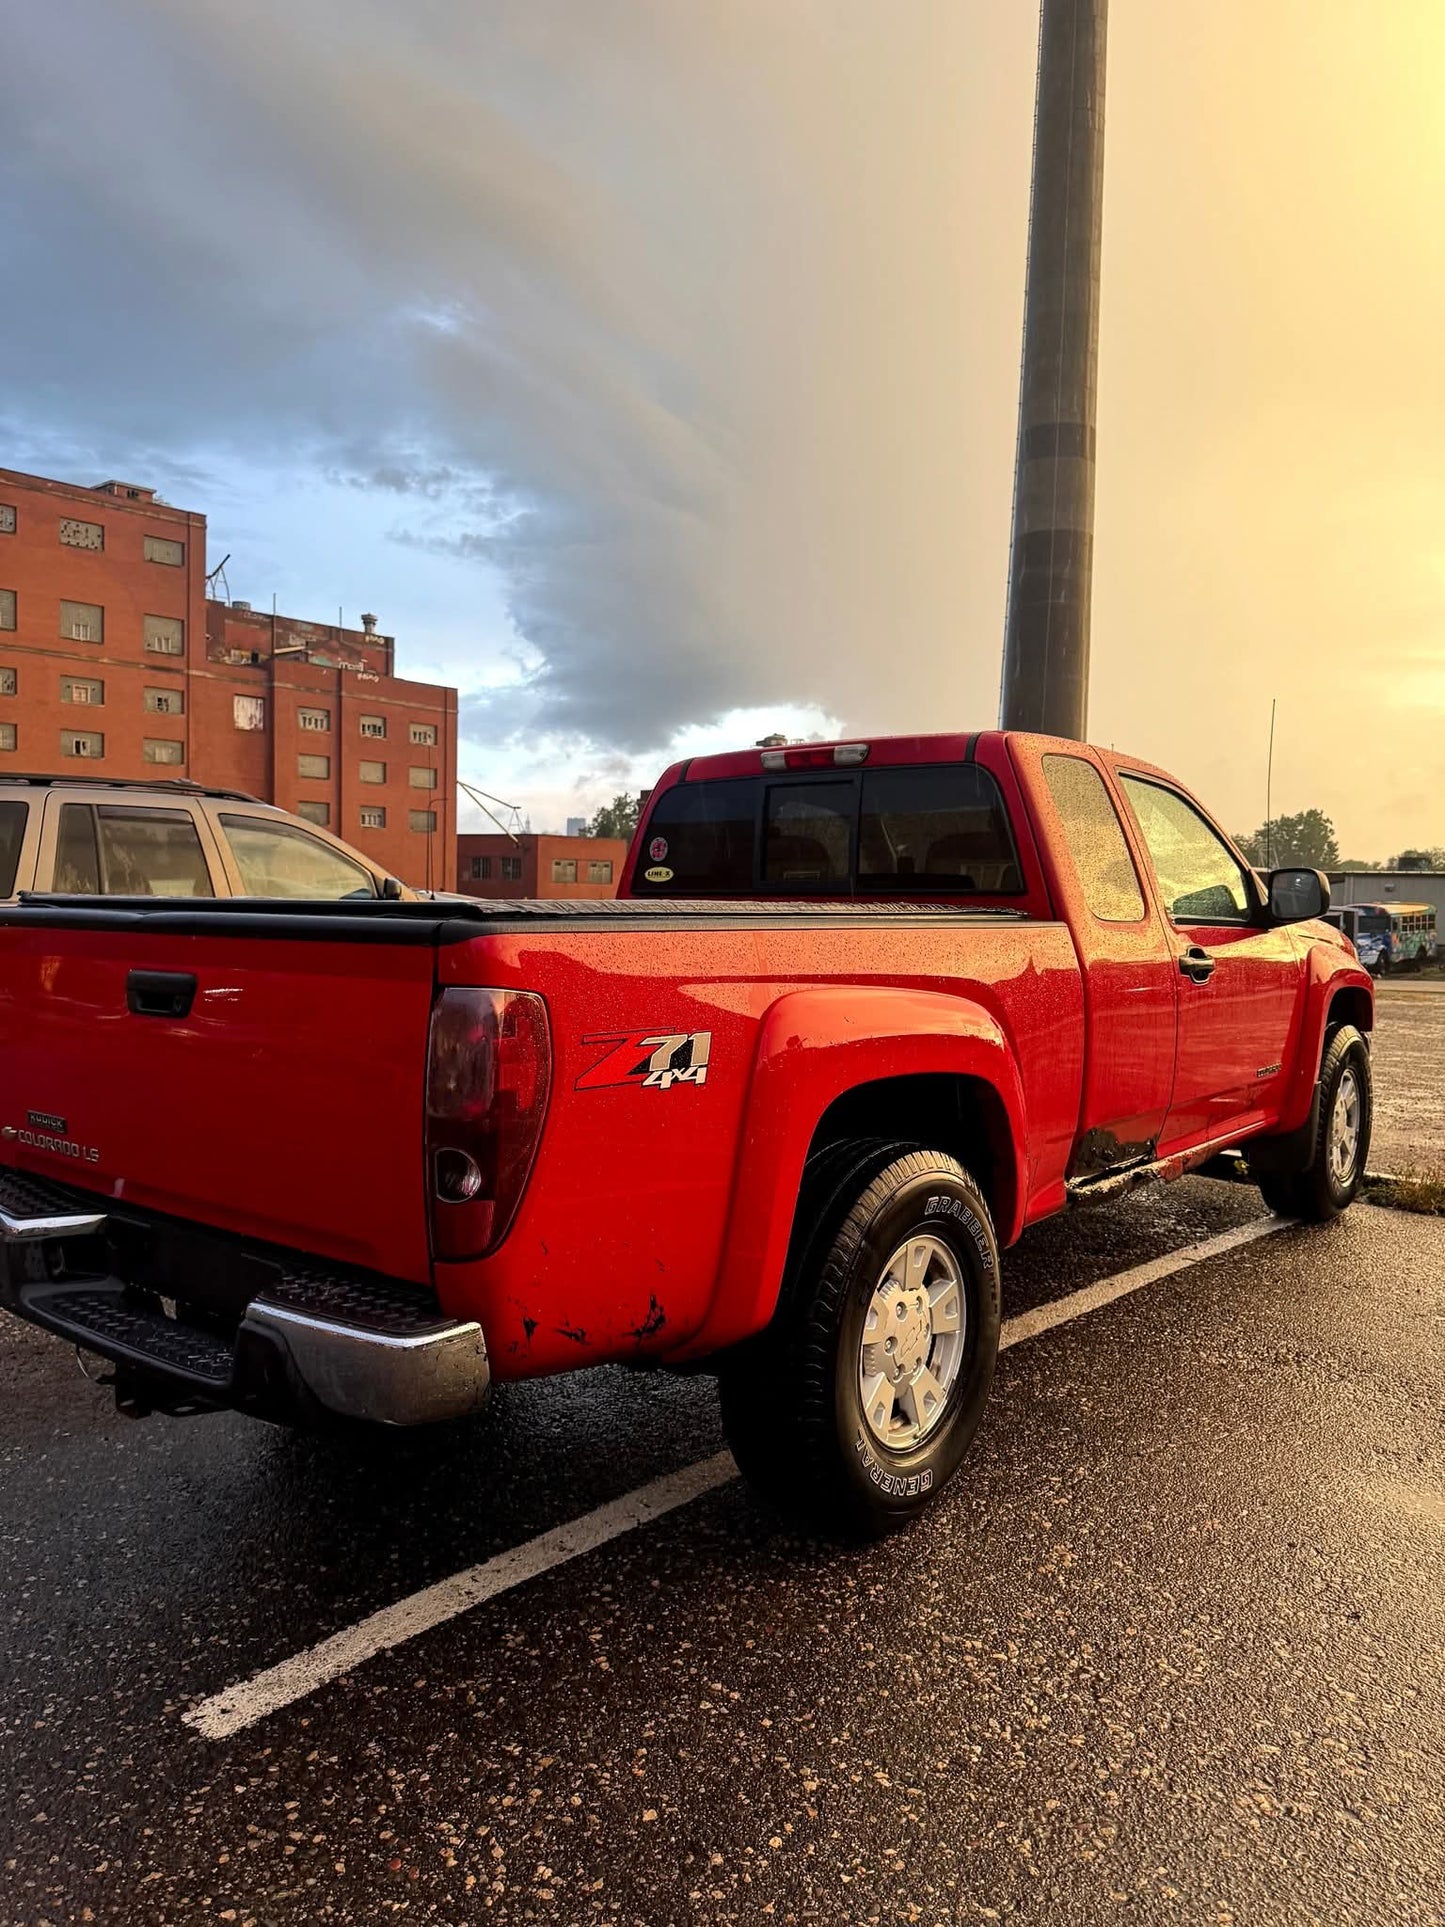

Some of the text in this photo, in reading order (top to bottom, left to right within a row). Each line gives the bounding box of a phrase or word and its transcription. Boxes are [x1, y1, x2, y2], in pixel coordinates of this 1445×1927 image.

[574, 1026, 712, 1090] Z71
[18, 1129, 99, 1162] COLORADO LS
[924, 1196, 994, 1269] GRABBER
[855, 1427, 933, 1496] GENERAL
